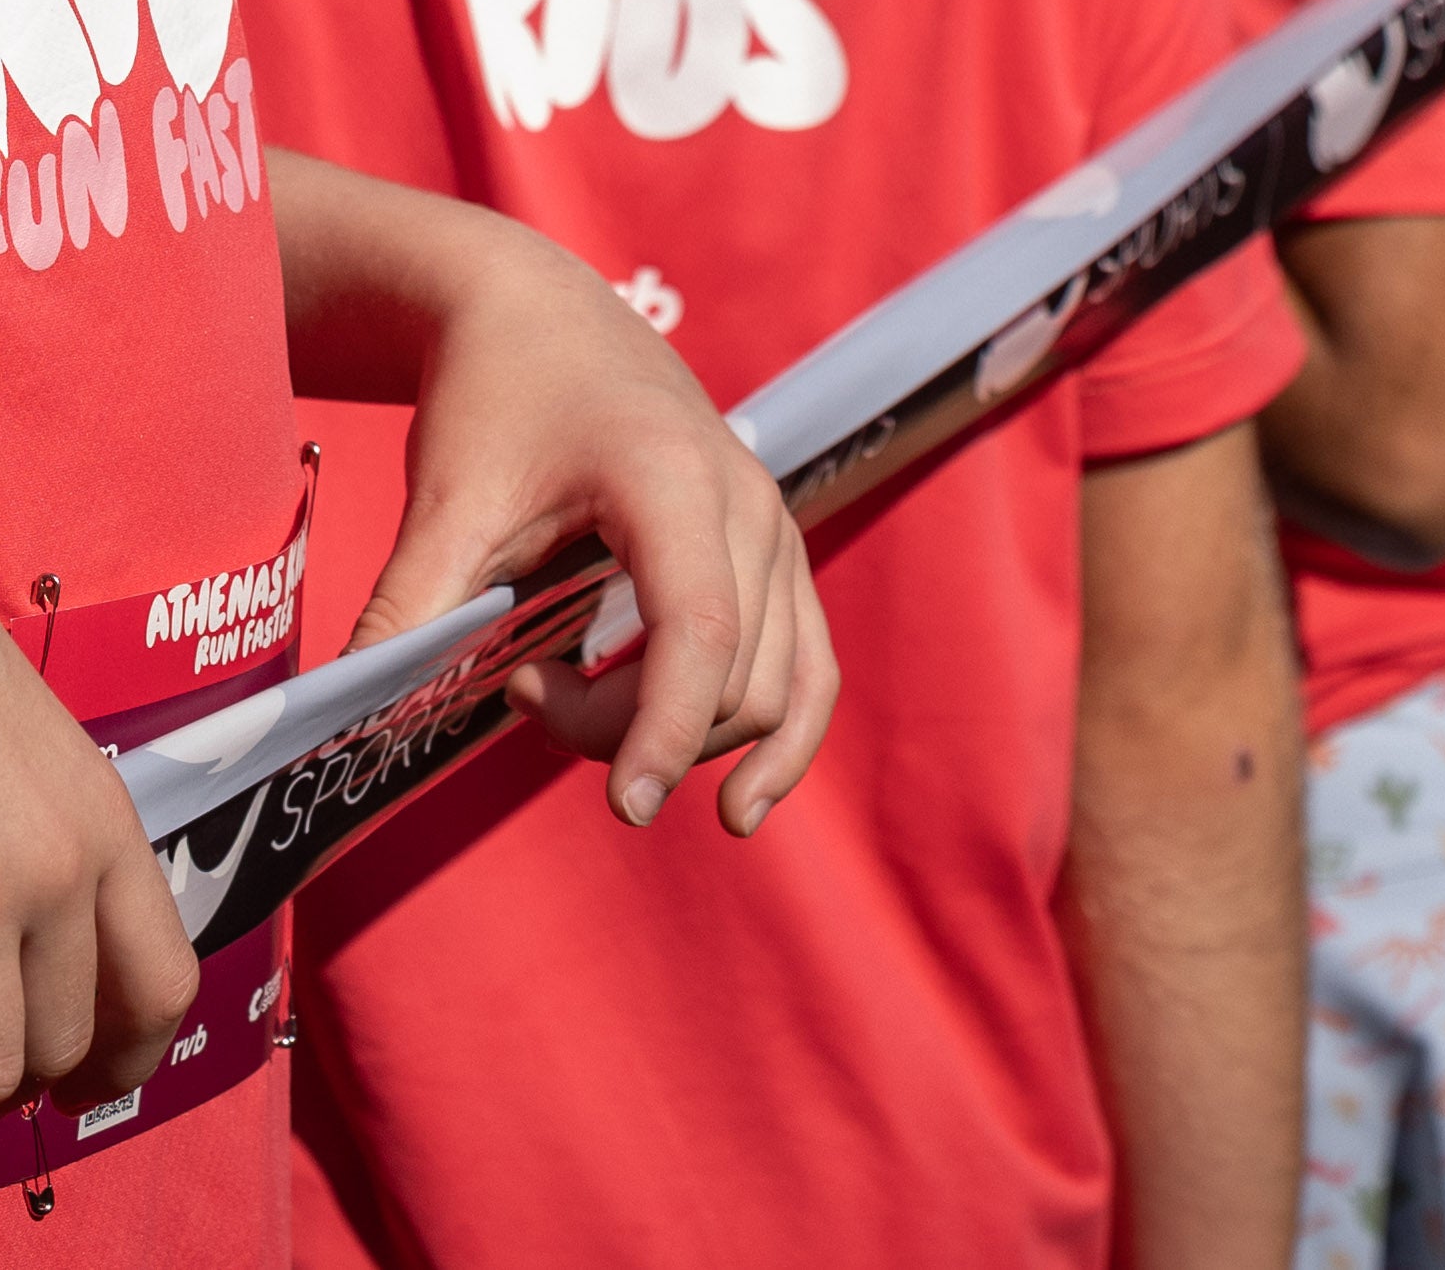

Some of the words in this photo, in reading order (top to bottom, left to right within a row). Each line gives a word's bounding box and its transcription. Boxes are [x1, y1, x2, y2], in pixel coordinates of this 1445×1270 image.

[146, 555, 286, 649] ATHENAS
[194, 625, 240, 675] RUN
[242, 595, 295, 659] FASTER
